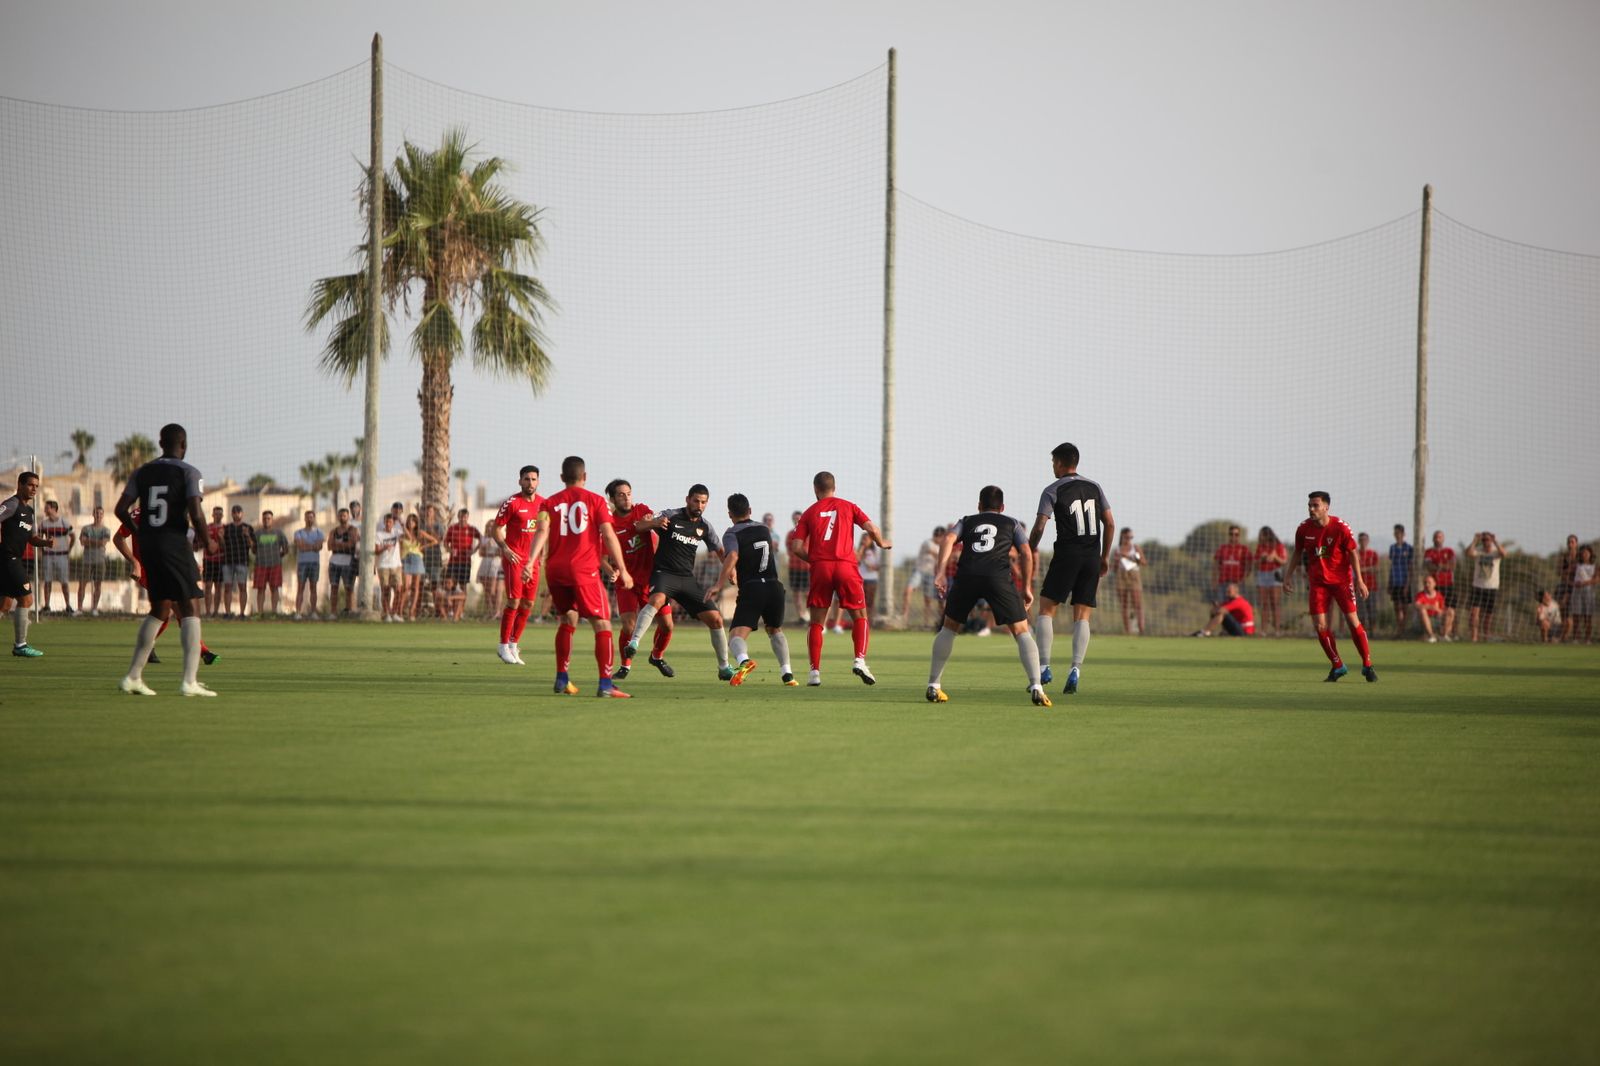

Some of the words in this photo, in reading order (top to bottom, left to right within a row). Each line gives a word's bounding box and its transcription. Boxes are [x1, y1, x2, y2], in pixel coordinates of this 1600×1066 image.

[148, 485, 168, 527] 5
[554, 501, 588, 536] 10
[1069, 499, 1097, 536] 11
[820, 510, 837, 541] 7
[971, 524, 998, 553] 3
[753, 541, 770, 573] 7
